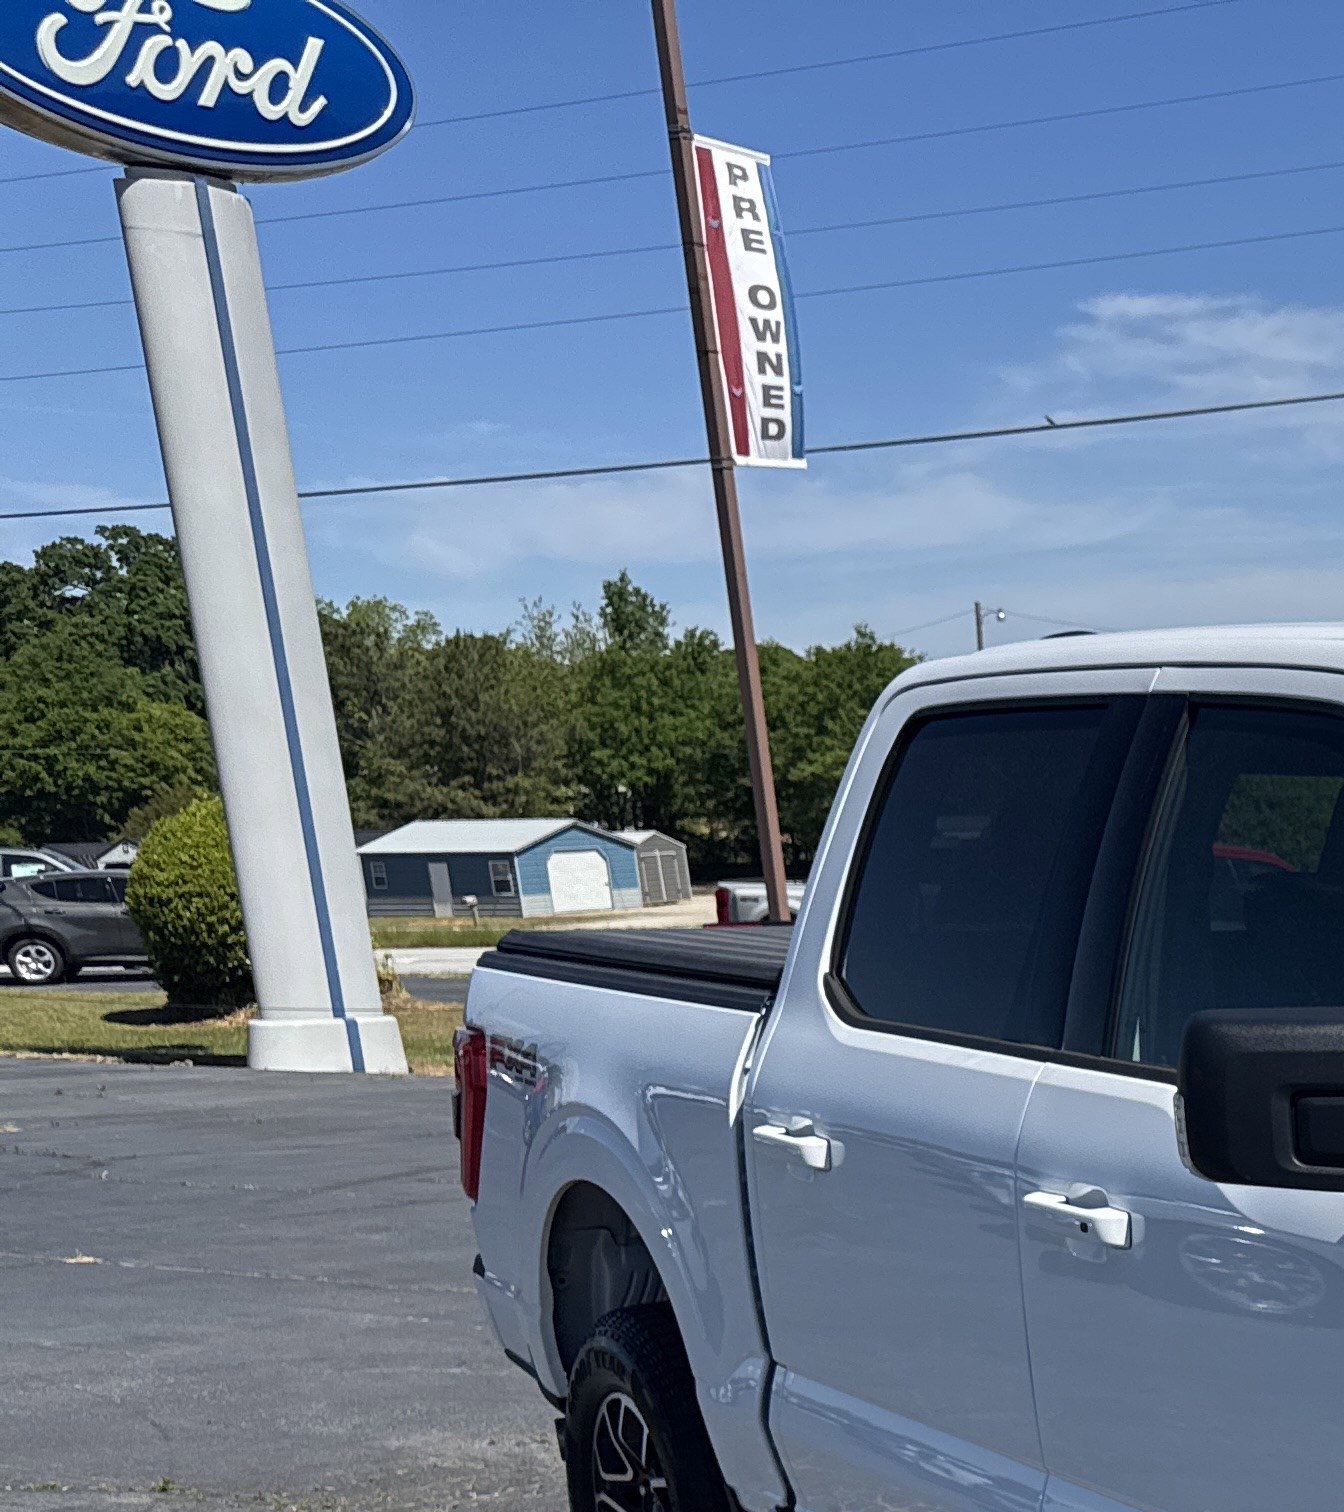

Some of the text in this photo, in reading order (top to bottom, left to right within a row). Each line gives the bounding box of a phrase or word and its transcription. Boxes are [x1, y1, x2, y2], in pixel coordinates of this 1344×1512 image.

[36, 0, 328, 127] Ford
[725, 161, 788, 441] PRE OWNED
